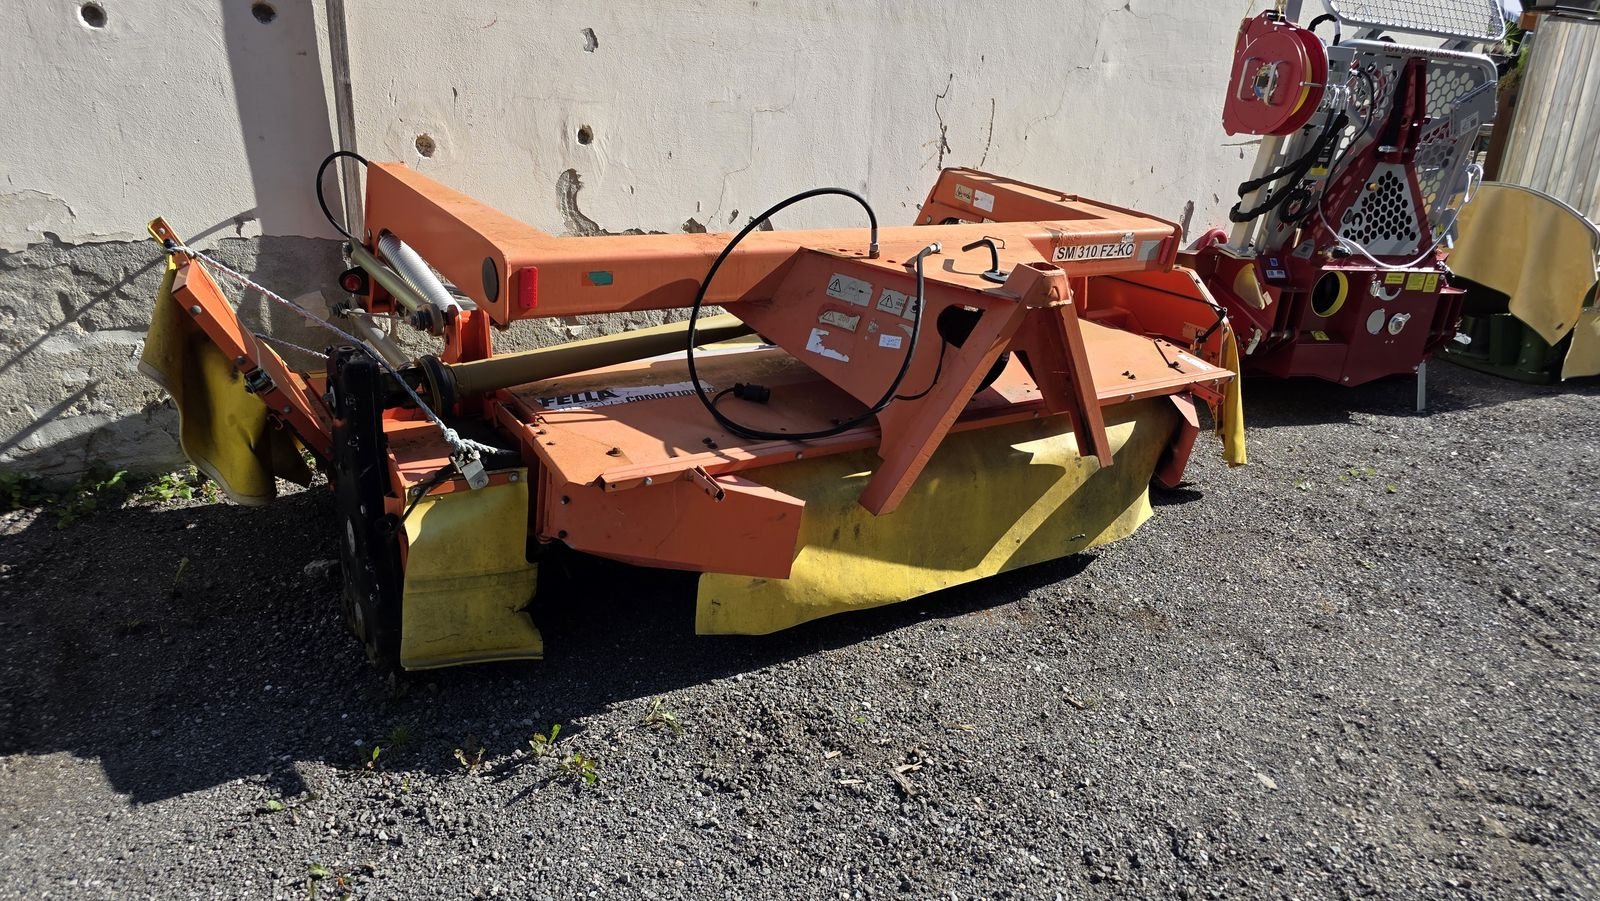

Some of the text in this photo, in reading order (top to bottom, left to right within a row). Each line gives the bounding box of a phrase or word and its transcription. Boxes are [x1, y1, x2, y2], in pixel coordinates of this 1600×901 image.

[1057, 244, 1134, 259] SM 310 FZ-KC
[541, 390, 620, 406] FELLA
